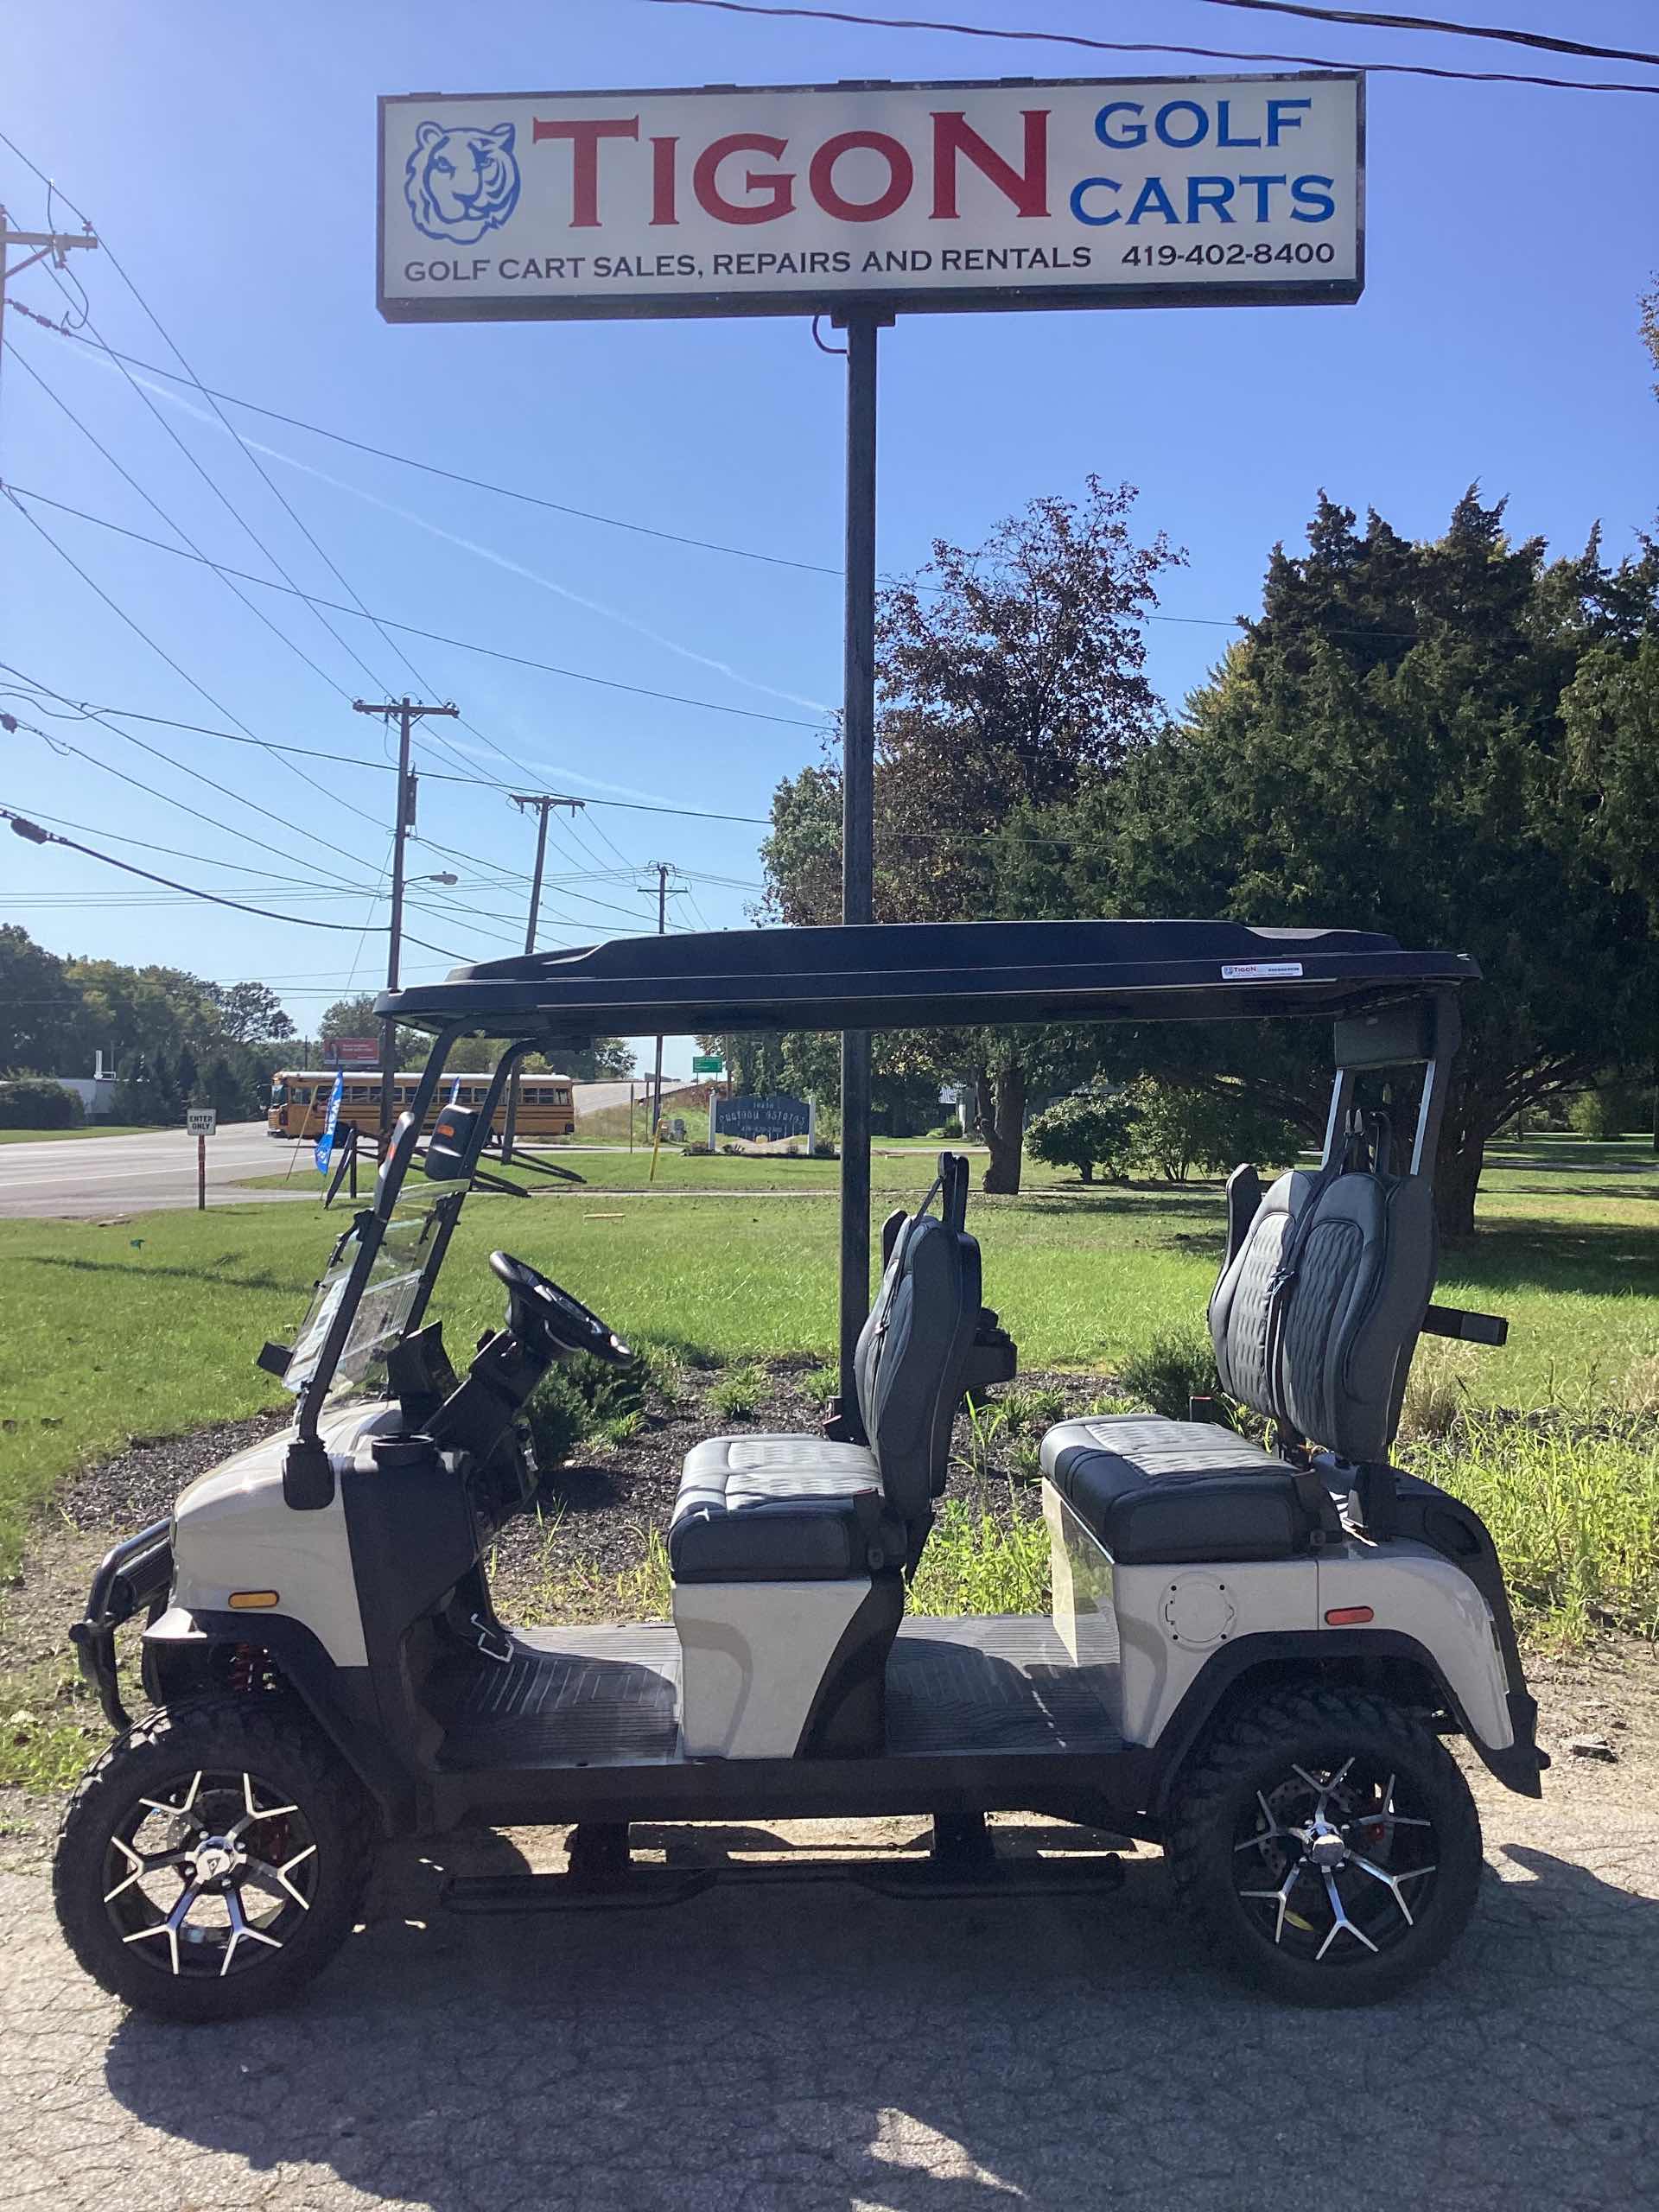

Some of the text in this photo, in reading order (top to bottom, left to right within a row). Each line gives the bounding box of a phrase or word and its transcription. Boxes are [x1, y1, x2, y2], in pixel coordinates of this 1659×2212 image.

[1095, 98, 1313, 149] GOLF
[532, 111, 1053, 229] TIGON
[1070, 175, 1336, 227] CARTS
[404, 246, 1092, 282] GOLF CART SALES, REPAIRS AND RENTALS
[1122, 243, 1336, 266] 419-402-8400
